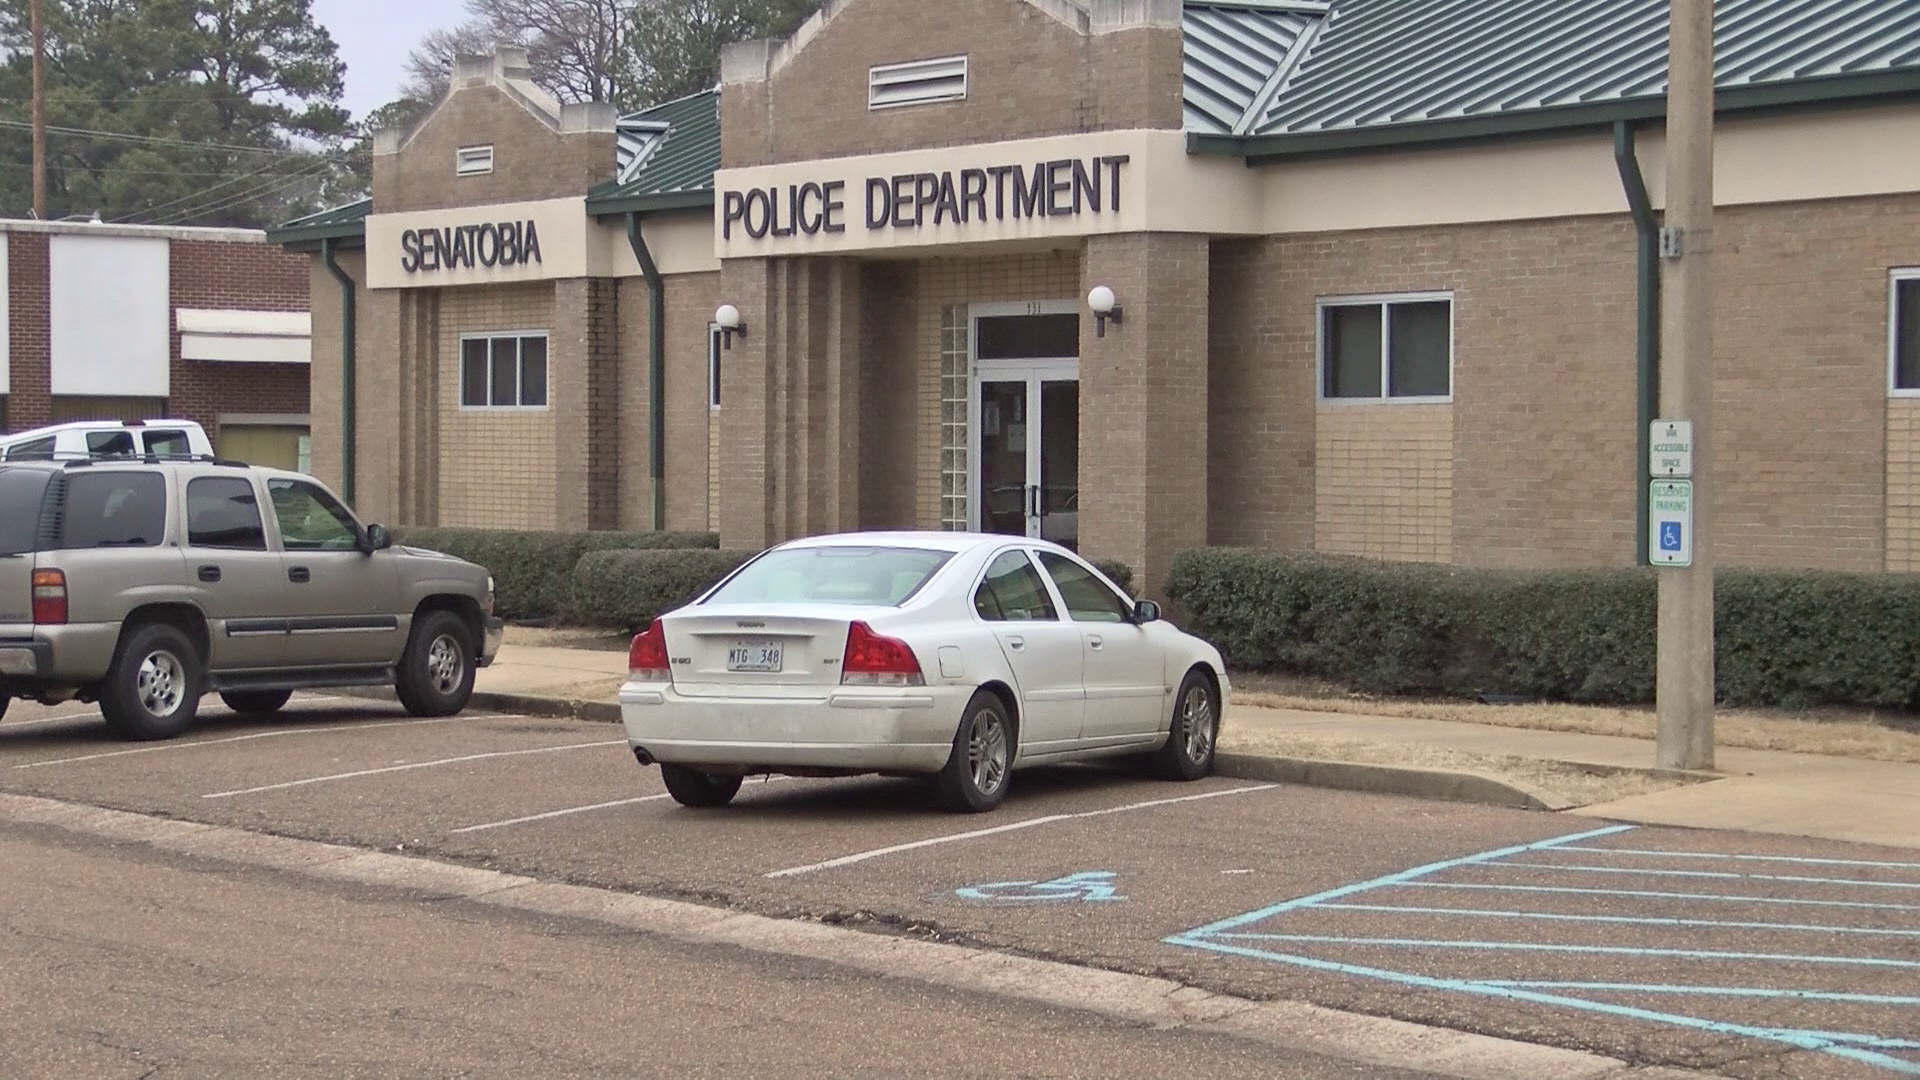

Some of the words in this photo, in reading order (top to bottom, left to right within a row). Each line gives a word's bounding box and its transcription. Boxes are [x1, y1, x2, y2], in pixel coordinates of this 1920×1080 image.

[723, 180, 846, 240] POLICE
[866, 155, 1130, 230] DEPARTMENT
[402, 220, 542, 273] SENATOBIA
[1654, 443, 1689, 452] ACCESSIBLE
[1662, 458, 1680, 467] SPACE
[1653, 486, 1690, 497] RESERVED
[1656, 500, 1687, 511] PARKING
[729, 648, 749, 663] MTG
[760, 648, 780, 664] 348
